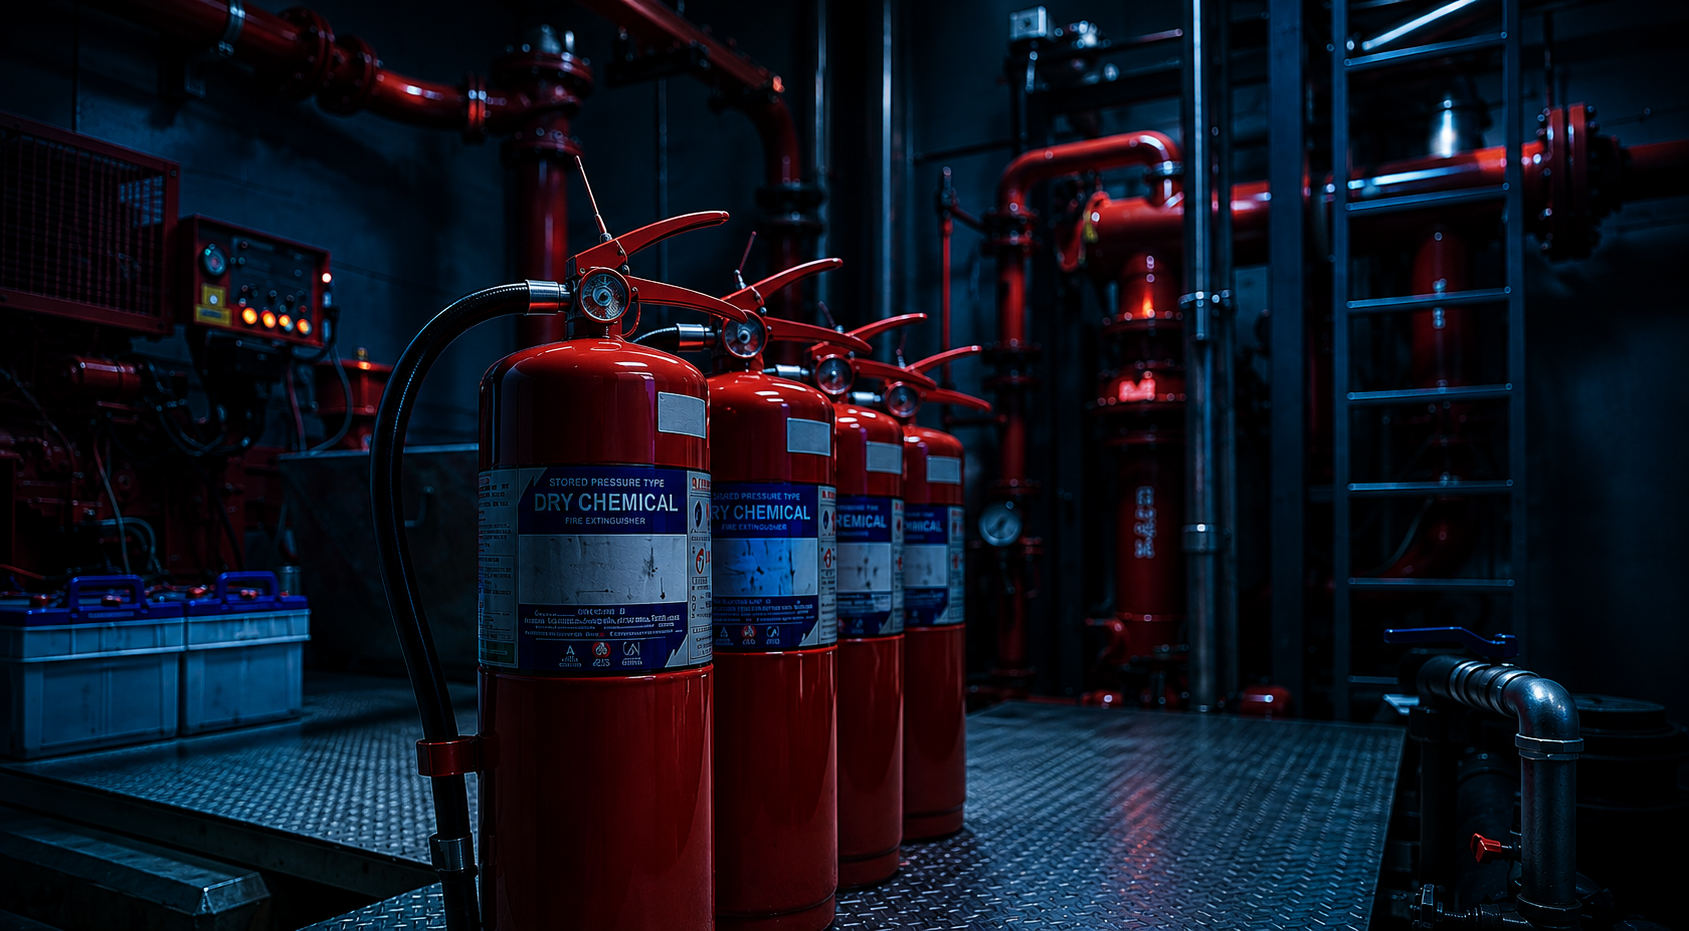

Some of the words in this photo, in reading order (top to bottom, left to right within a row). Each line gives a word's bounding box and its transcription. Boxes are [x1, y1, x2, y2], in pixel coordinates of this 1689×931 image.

[549, 477, 589, 487] STORED
[591, 477, 641, 488] PRESSURE
[643, 478, 665, 488] TYPE
[534, 493, 574, 512] DRY
[578, 492, 679, 512] CHEMICAL
[783, 492, 801, 501] TYPE
[711, 504, 730, 520] RY
[733, 504, 811, 520] CHEMICAL
[565, 516, 584, 525] FIRE
[585, 516, 646, 525] EXTINGUISHER
